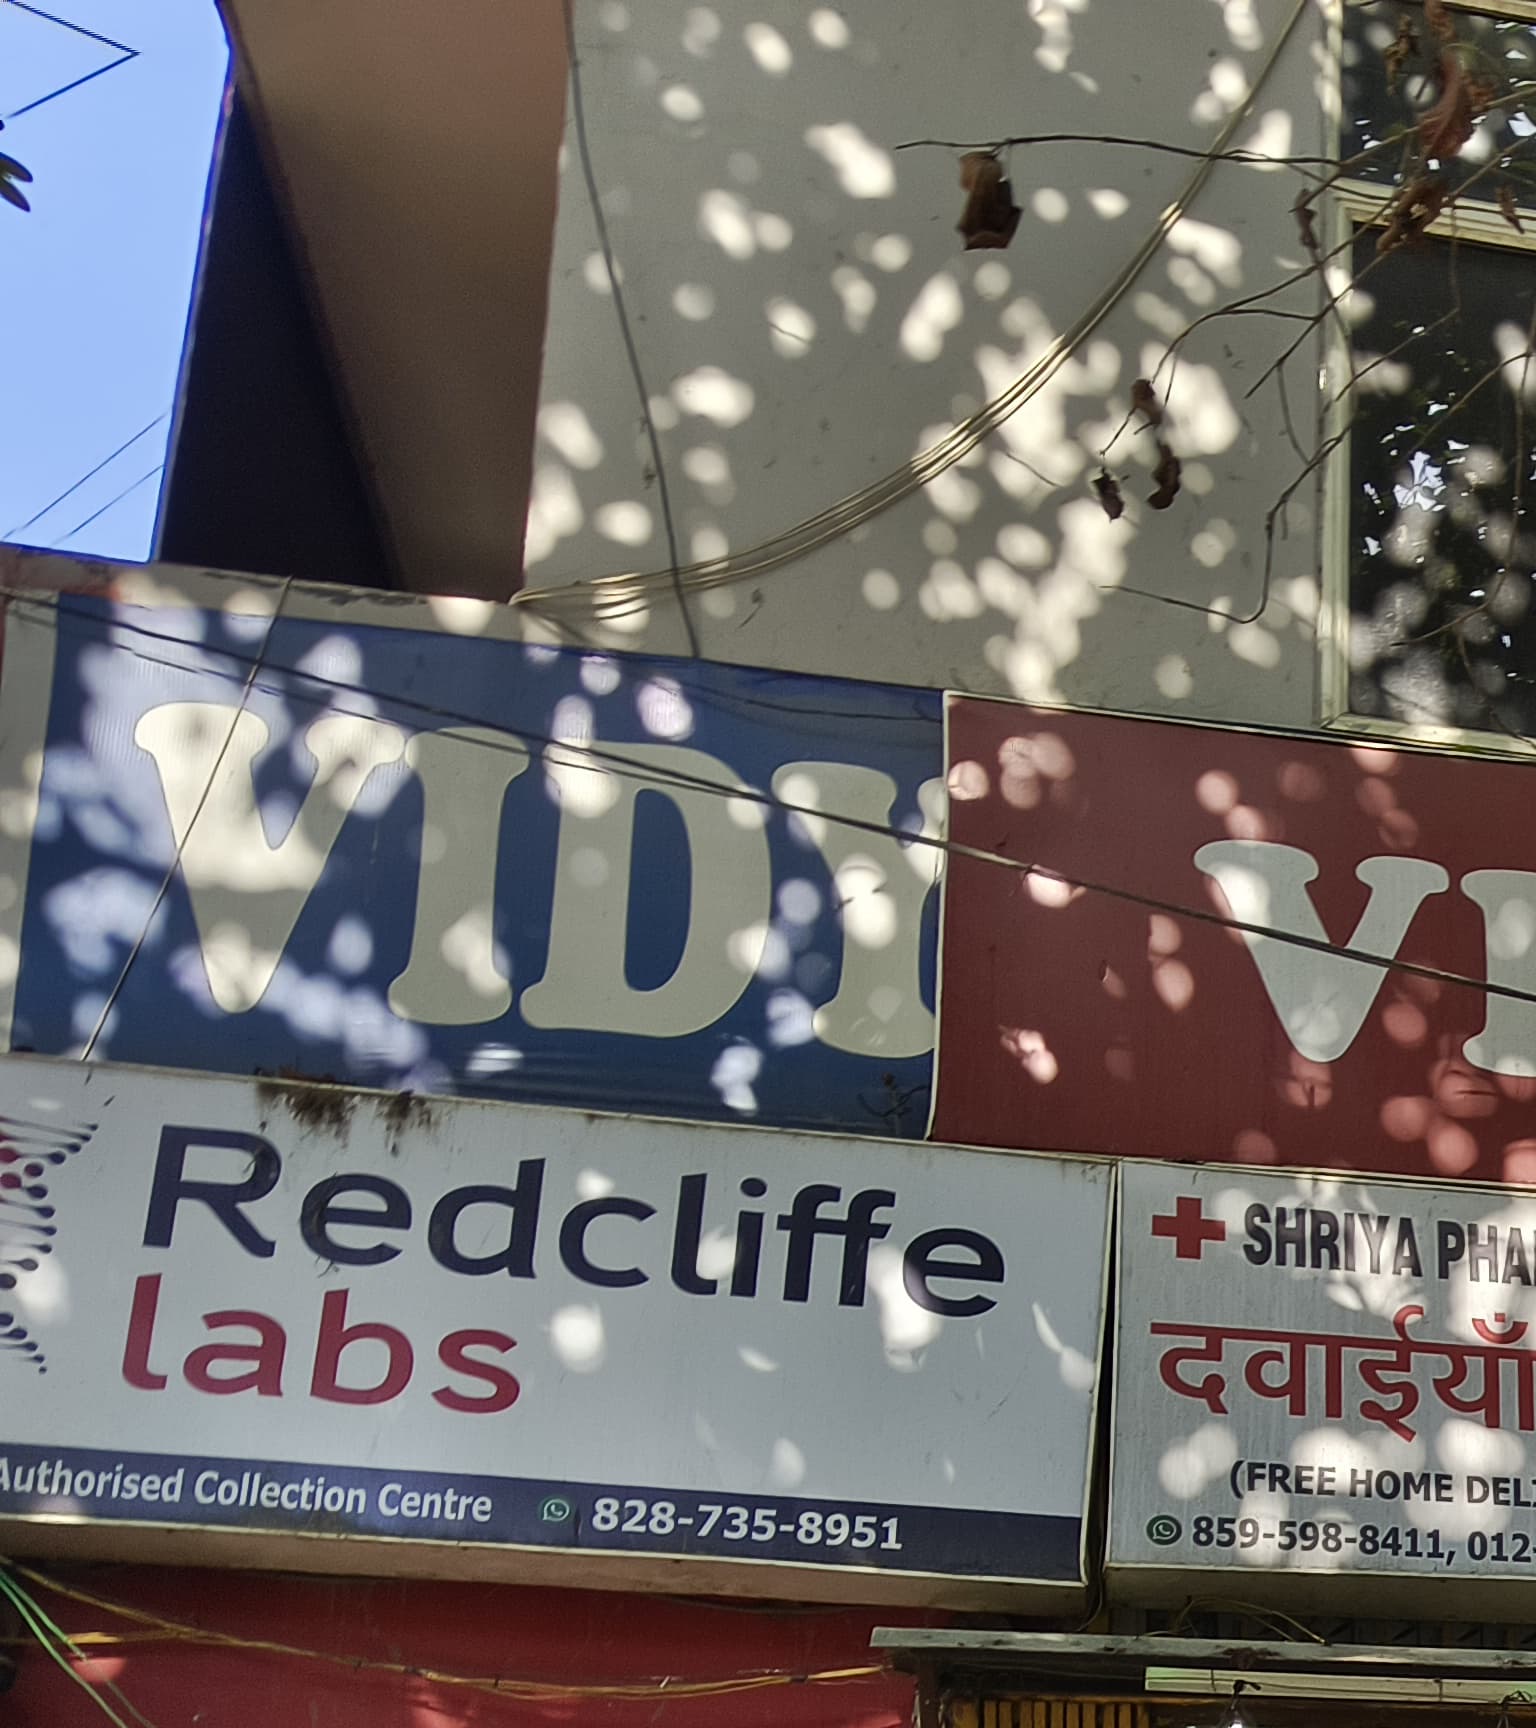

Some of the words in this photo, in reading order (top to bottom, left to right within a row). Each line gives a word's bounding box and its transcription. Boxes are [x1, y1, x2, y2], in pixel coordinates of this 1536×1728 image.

[141, 1124, 1006, 1320] Redcliffe
[1242, 1202, 1423, 1280] SHRIYA
[120, 1273, 522, 1415] labs
[193, 1470, 367, 1516] Collection
[376, 1484, 494, 1524] Centre
[1229, 1460, 1336, 1498] (FREE
[1348, 1469, 1454, 1507] HOME
[592, 1496, 903, 1553] 828-735-8951
[1191, 1515, 1458, 1567] 859-598-8411,
